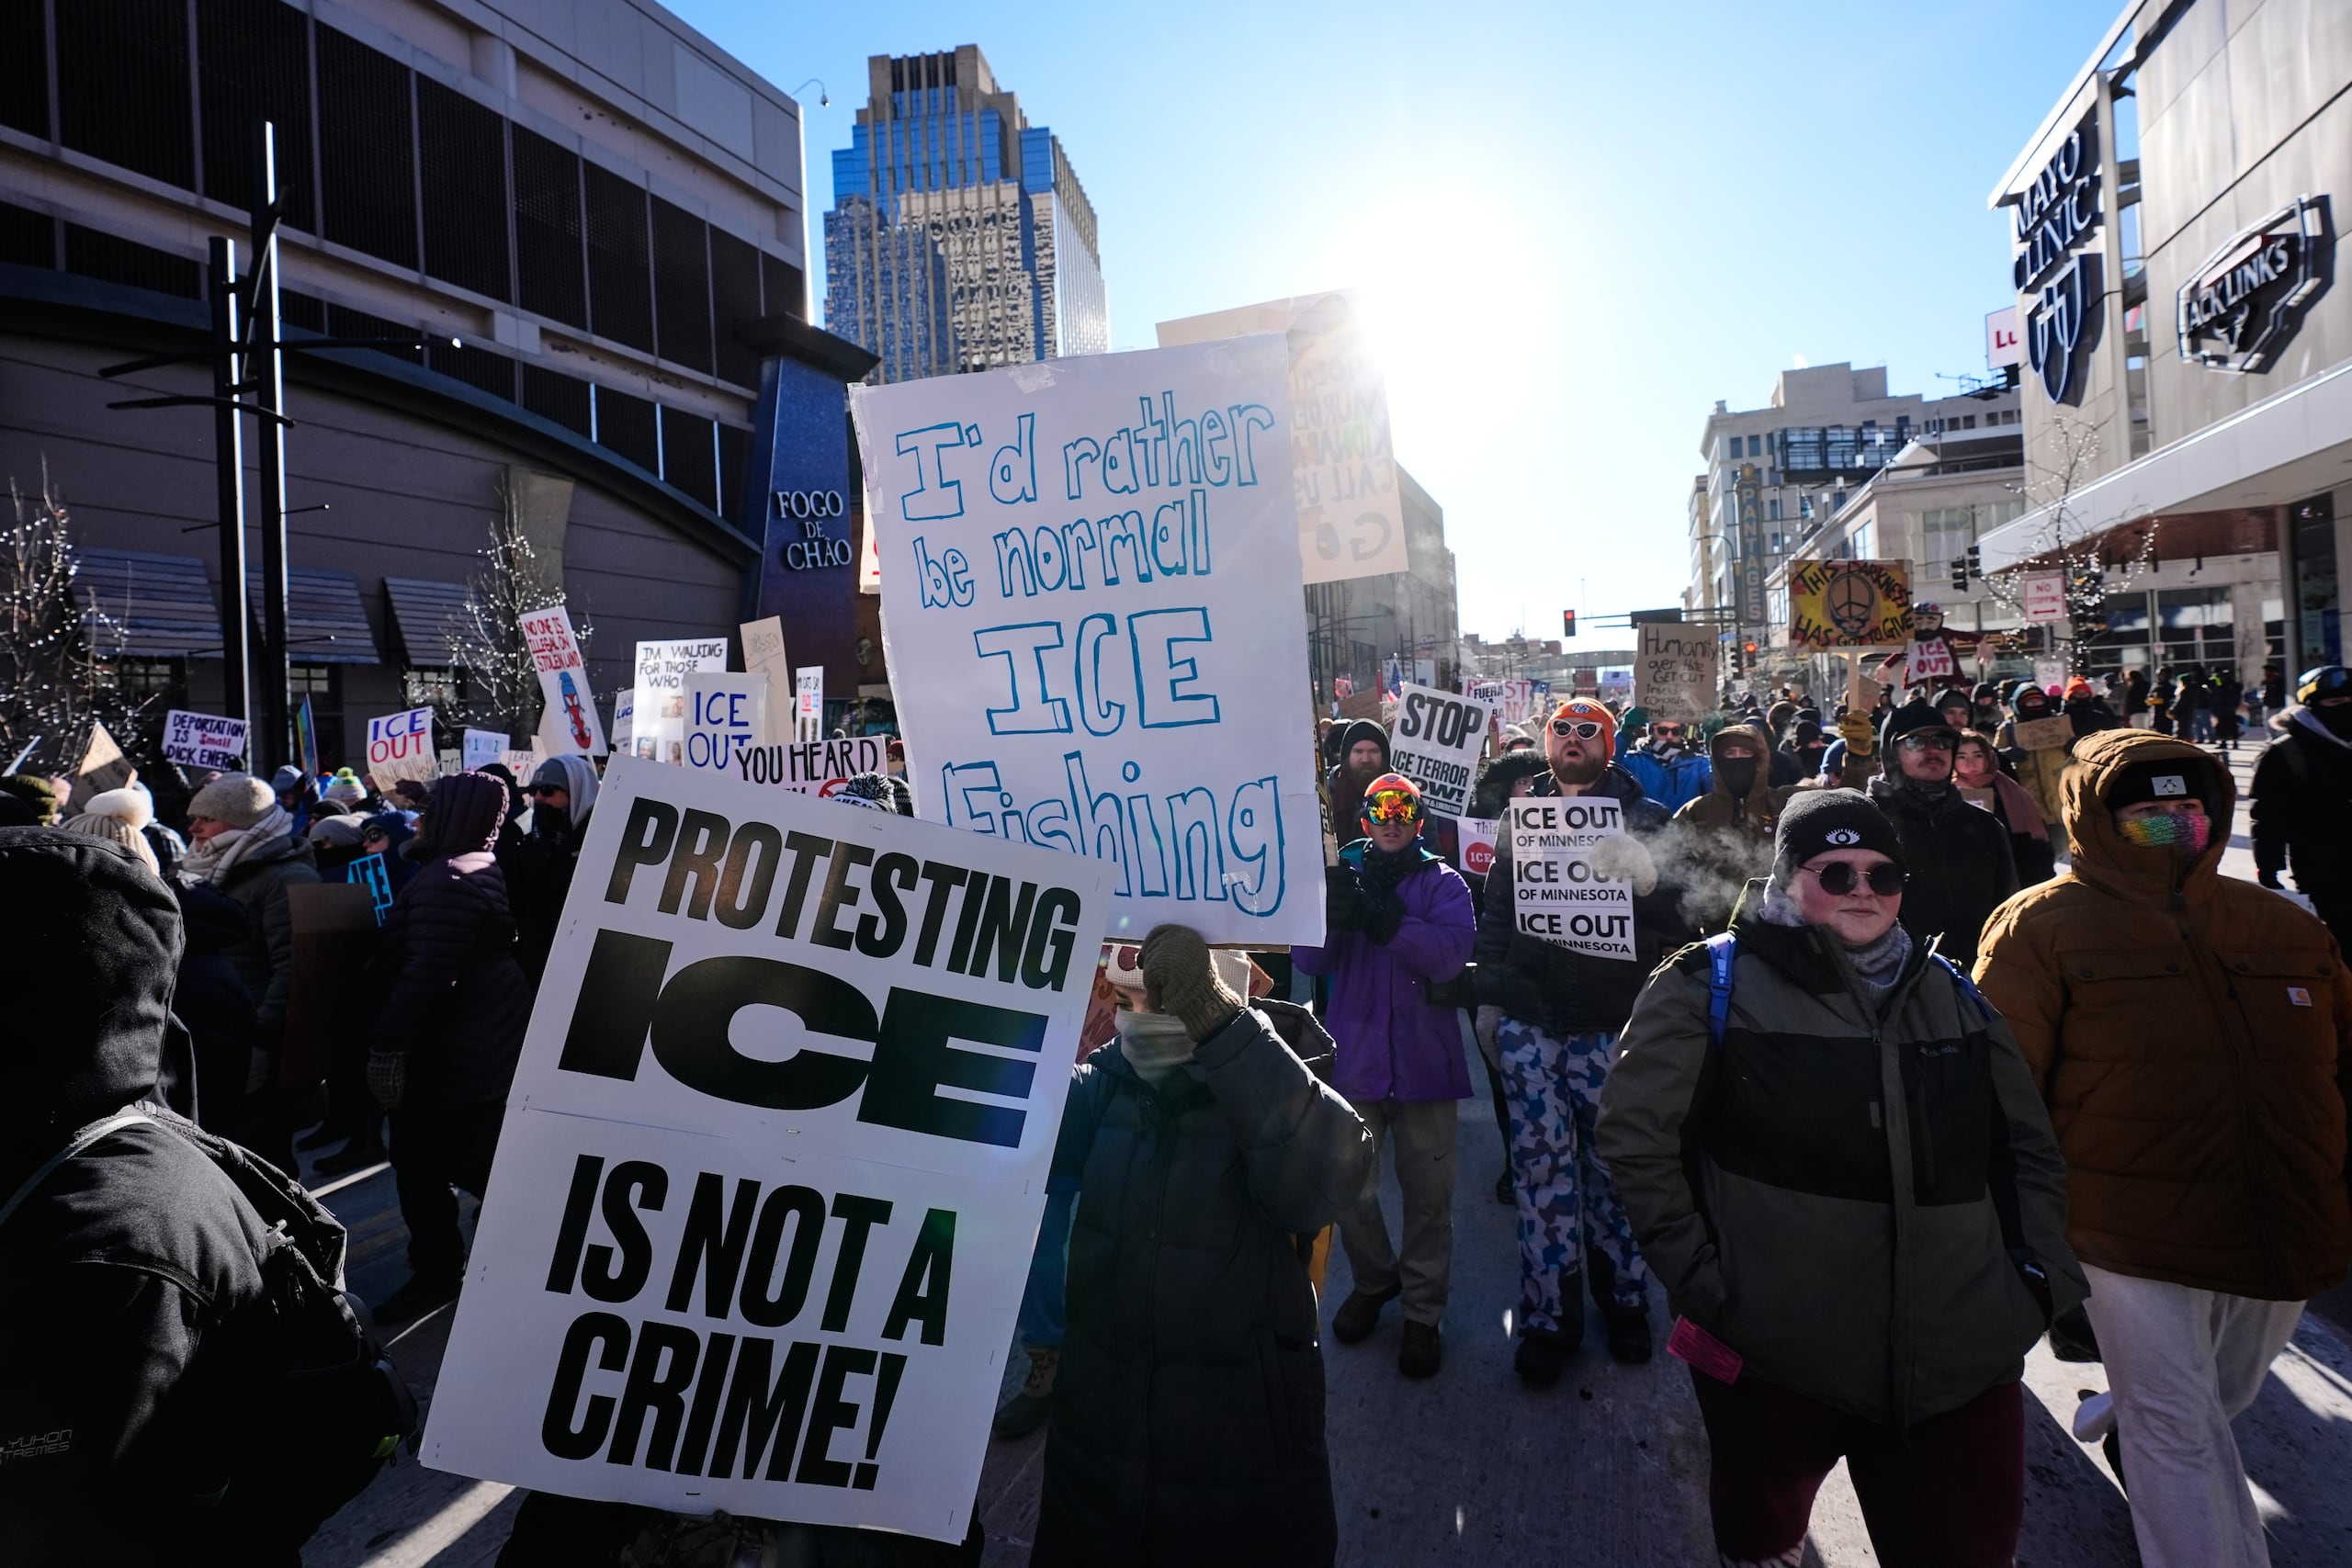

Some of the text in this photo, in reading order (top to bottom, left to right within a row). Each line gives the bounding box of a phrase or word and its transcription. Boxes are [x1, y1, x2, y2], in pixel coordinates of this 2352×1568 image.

[2017, 130, 2080, 243] MAYO
[2014, 175, 2091, 294] CLINIC
[896, 389, 1275, 521] I'd rather
[776, 491, 843, 518] FOGO
[805, 521, 825, 538] DE
[787, 537, 852, 570] CHÃO
[913, 536, 975, 609] be
[994, 489, 1211, 598] normal
[1741, 487, 1761, 620] PANTAGES
[1792, 560, 1913, 608] THIS DARKNESS
[2036, 583, 2051, 592] NO
[525, 616, 564, 636] NO ONE IS
[1792, 615, 1834, 647] HAS
[1866, 627, 1883, 644] TO
[1882, 607, 1914, 639] GIVE
[528, 636, 571, 654] ILLEGAL ON
[671, 643, 723, 658] WALKING
[1645, 626, 1717, 661] Humanity
[1918, 641, 1946, 656] ICE
[537, 650, 581, 672] STOLEN LAND
[639, 660, 698, 675] FOR THOSE
[973, 606, 1220, 736] ICE
[1917, 657, 1950, 673] OUT
[648, 677, 679, 689] WHO
[1680, 672, 1705, 682] OUT
[1474, 685, 1503, 699] FUERA
[695, 691, 749, 727] ICE
[1399, 693, 1484, 750] STOP
[172, 729, 188, 743] IS
[173, 714, 245, 738] DEPORTATION
[372, 709, 427, 741] ICE
[166, 745, 197, 765] DICK
[370, 731, 426, 763] OUT
[689, 732, 752, 770] OUT
[735, 739, 878, 784] YOU HEARD
[1392, 750, 1470, 787] ICE TERROR
[1403, 774, 1465, 803] OW!
[1475, 821, 1498, 834] This
[1513, 806, 1619, 829] ICE OUT
[942, 750, 1285, 917] Fishing
[1516, 835, 1534, 847] OF
[1471, 852, 1492, 863] ICE
[1517, 861, 1558, 884] ICE
[604, 795, 1081, 993] PROTESTING
[1518, 889, 1627, 901] OF MINNESOTA
[1520, 913, 1630, 938] ICE OUT
[557, 928, 1049, 1149] ICE
[545, 1154, 957, 1347] IS NOT A
[541, 1311, 908, 1491] CRIME!
[8, 1429, 73, 1448] YUKON
